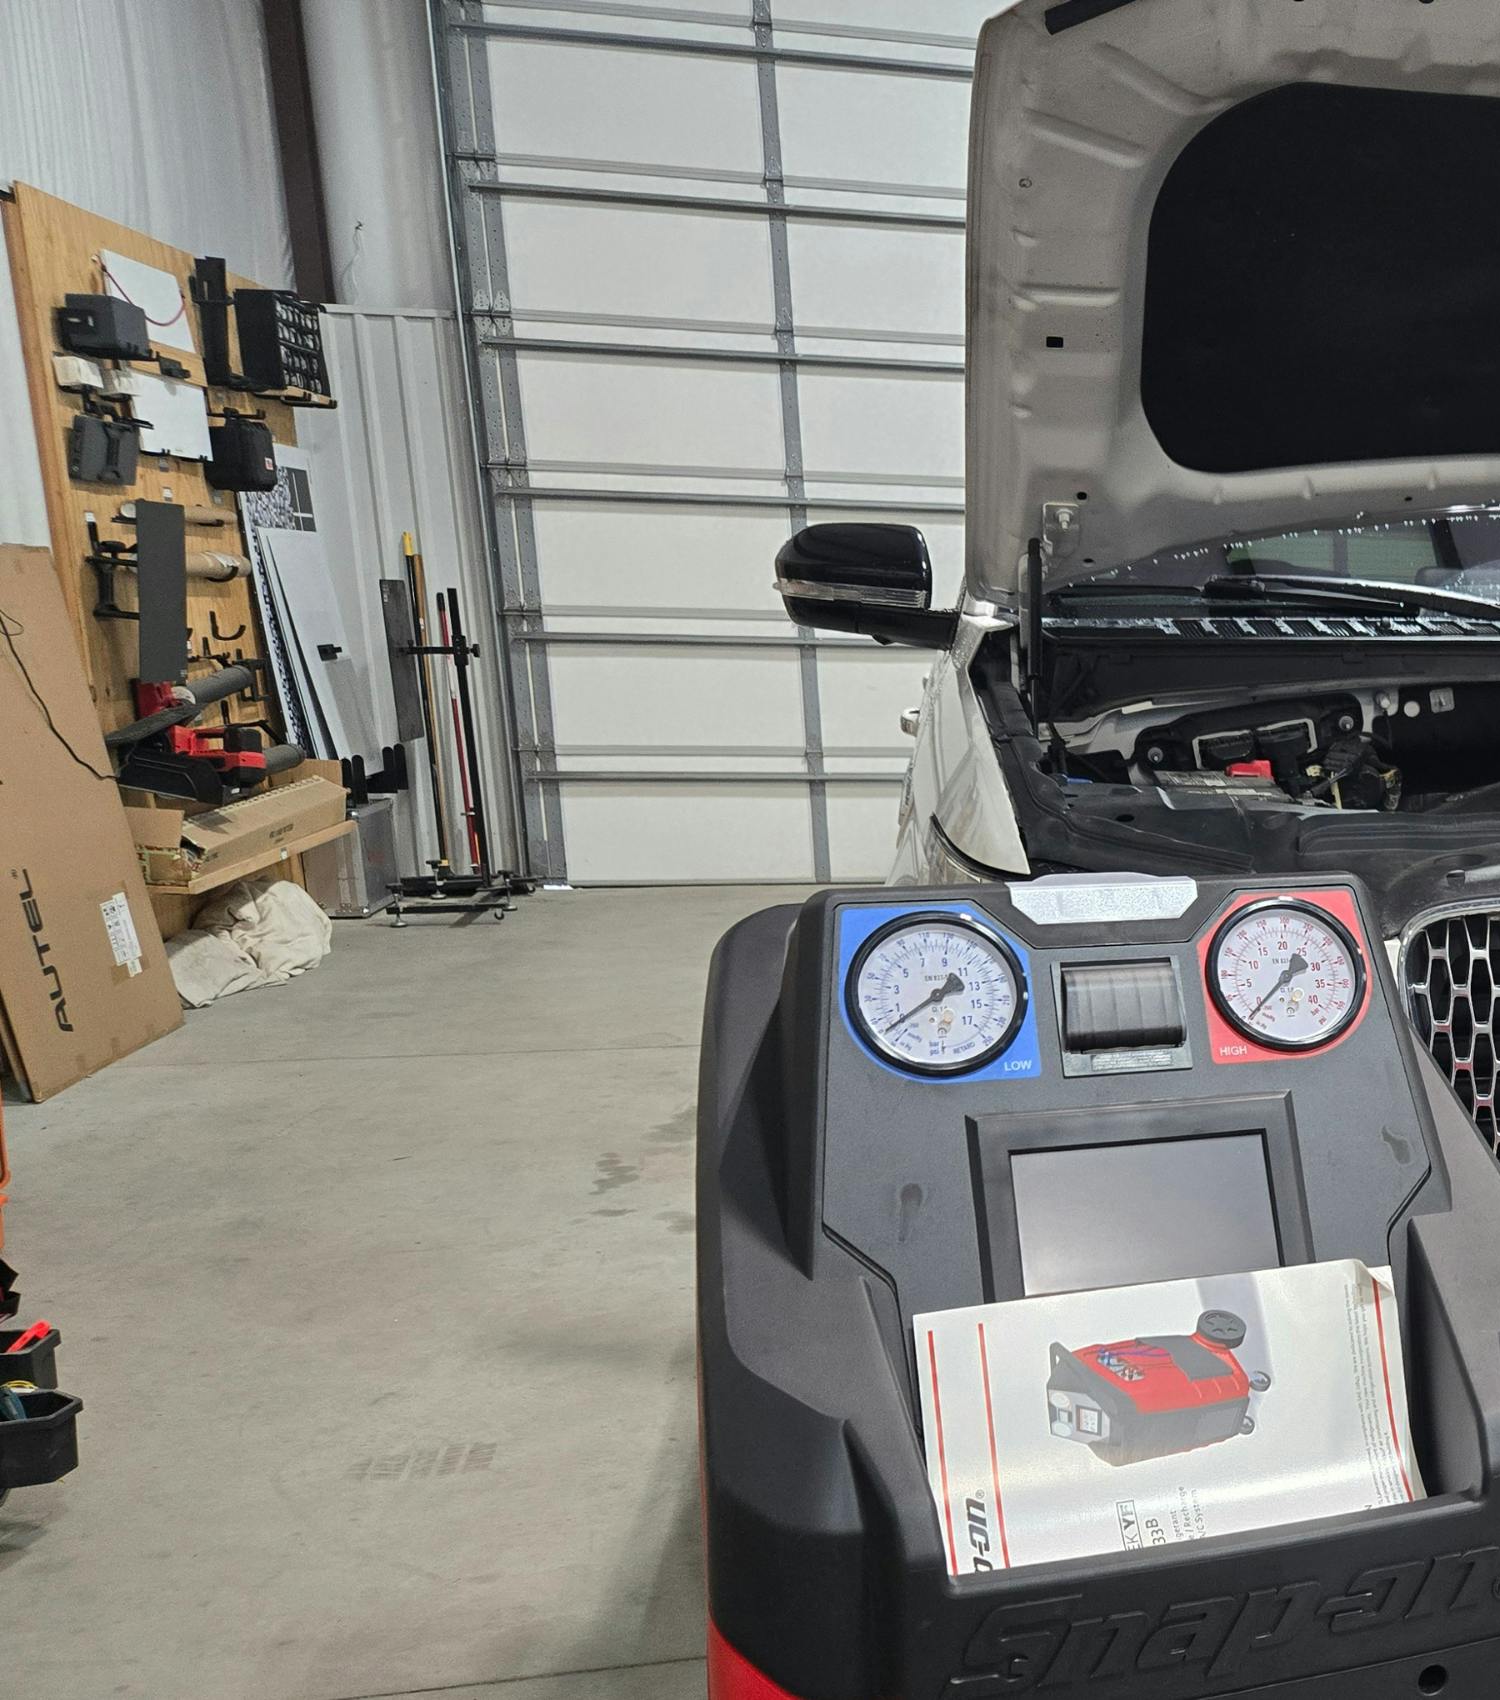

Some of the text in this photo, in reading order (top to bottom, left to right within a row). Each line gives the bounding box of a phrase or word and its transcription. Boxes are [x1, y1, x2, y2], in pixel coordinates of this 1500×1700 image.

[1277, 941, 1288, 950] 20
[19, 869, 74, 1032] AUTEL
[1258, 948, 1268, 957] 15
[1296, 948, 1307, 957] 25
[920, 958, 925, 967] 7
[942, 958, 948, 967] 9
[1250, 960, 1259, 970] 10
[1311, 962, 1321, 971] 30
[902, 968, 909, 978] 5
[958, 967, 968, 977] 11
[969, 982, 980, 991] 13
[1247, 979, 1252, 988] 5
[1315, 979, 1326, 988] 35
[894, 985, 900, 995] 3
[1308, 994, 1319, 1004] 40
[970, 1000, 981, 1009] 15
[962, 1016, 972, 1025] 17
[1219, 1046, 1247, 1056] HIGH
[1004, 1061, 1032, 1071] LOW
[945, 1546, 1500, 1693] Snap-on
